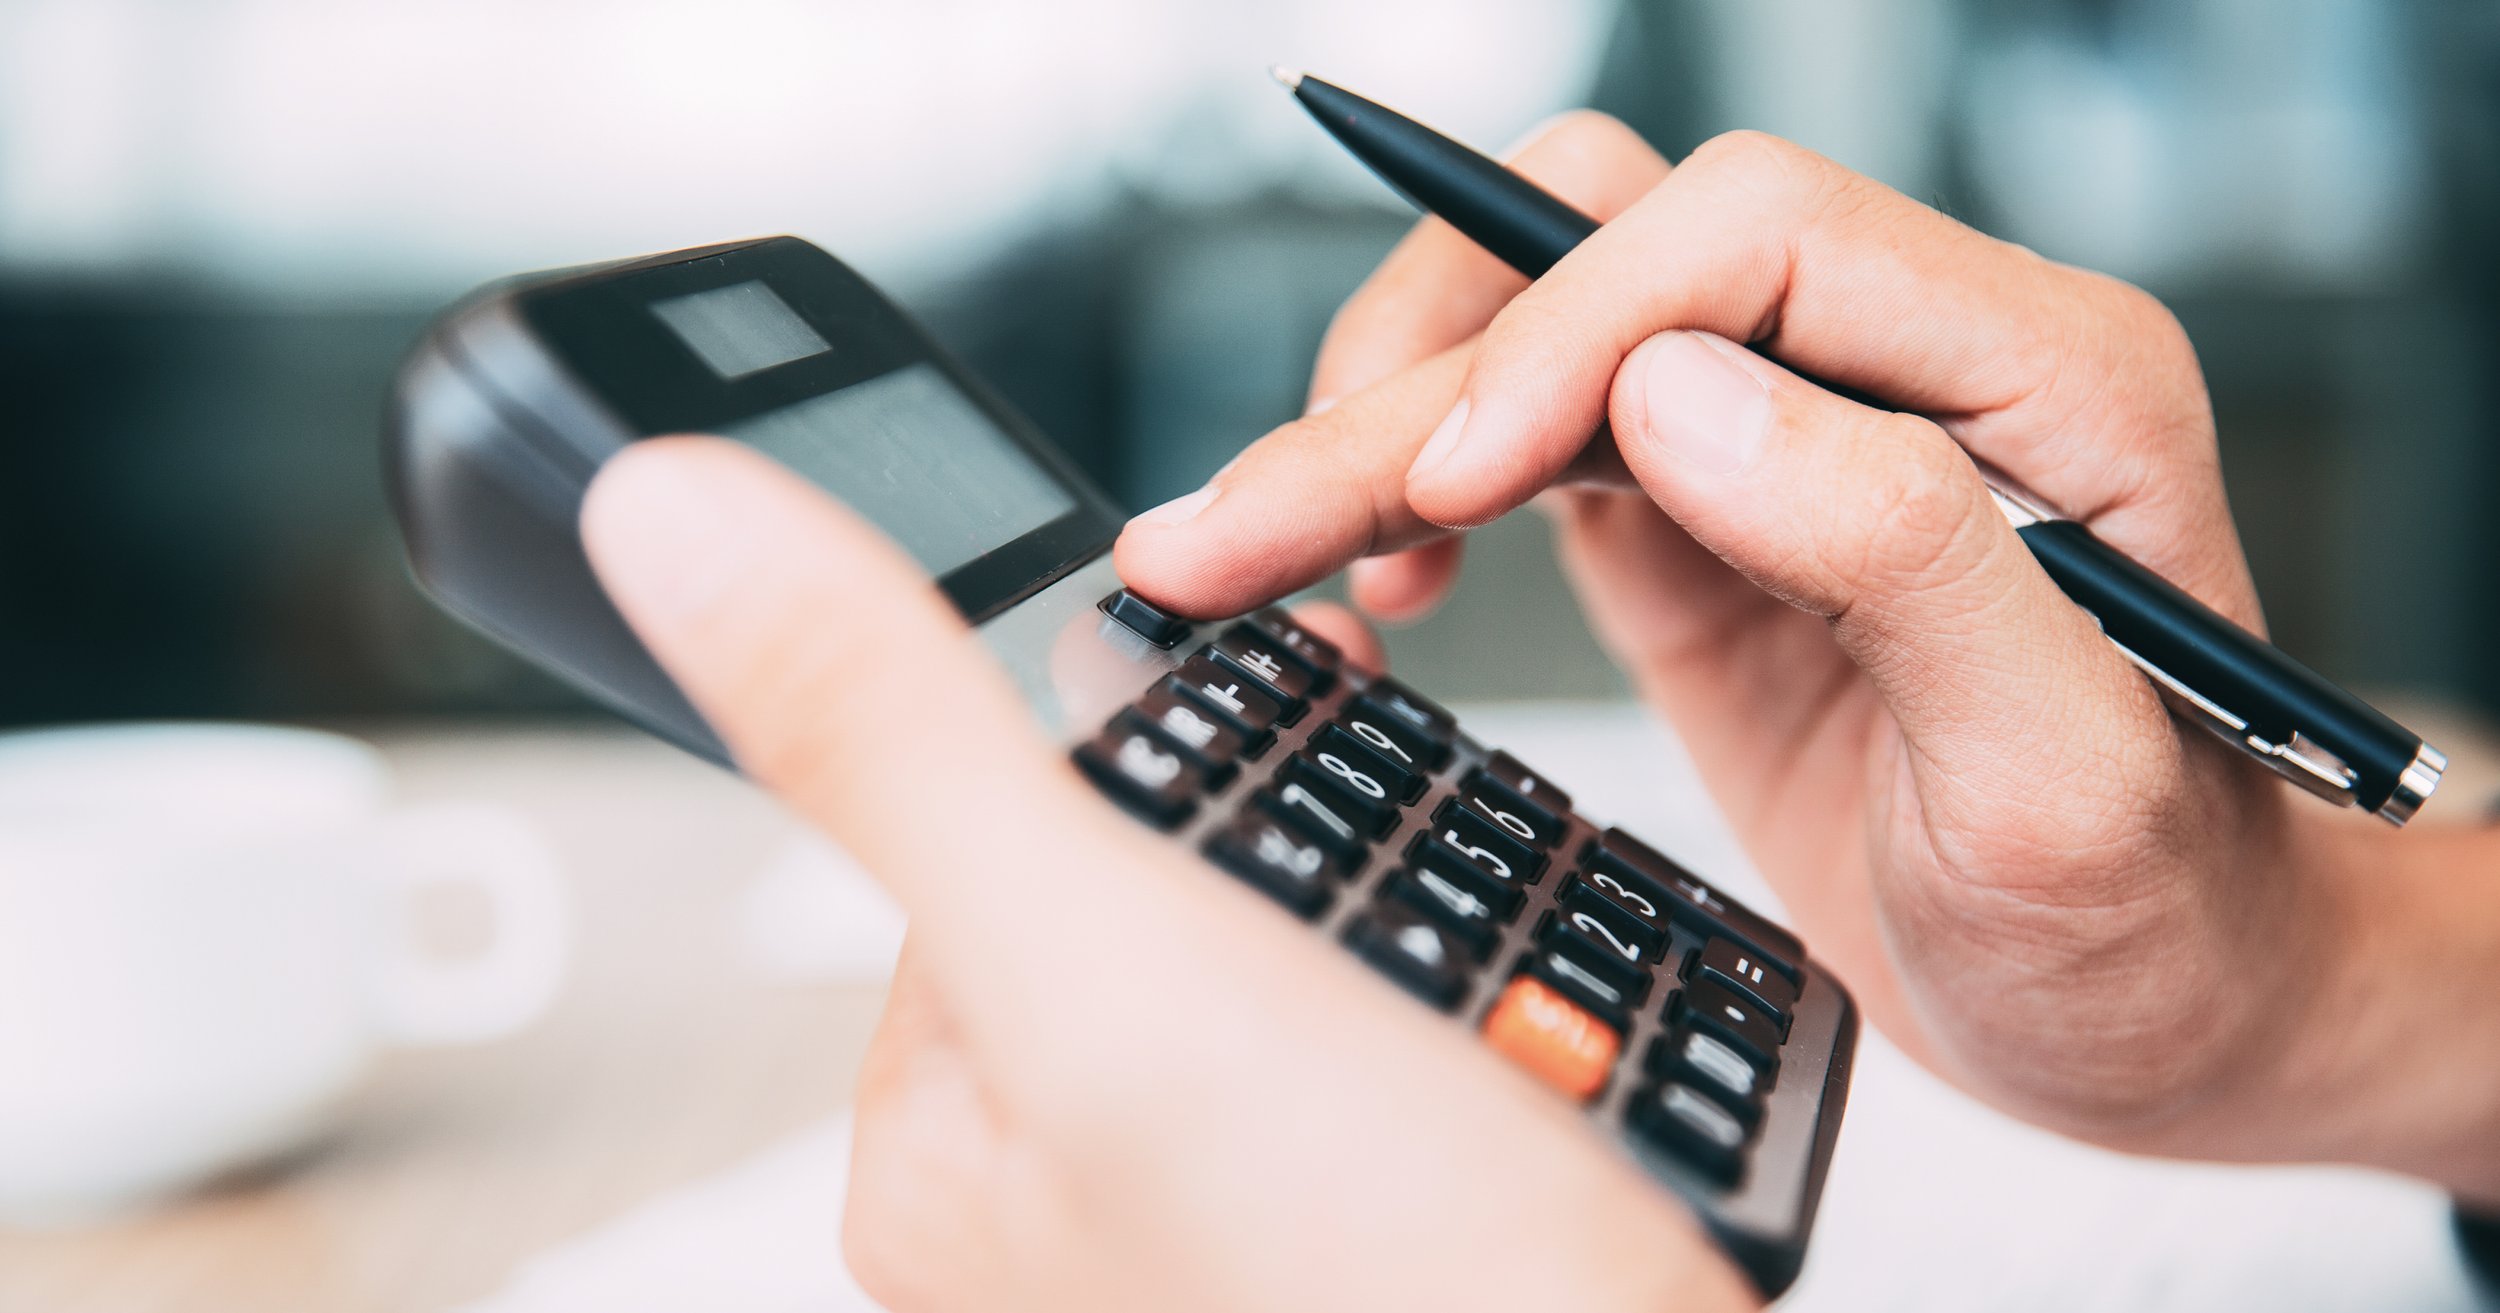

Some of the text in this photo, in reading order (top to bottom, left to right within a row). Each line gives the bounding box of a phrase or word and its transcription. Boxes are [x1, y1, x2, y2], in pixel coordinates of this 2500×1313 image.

[1351, 721, 1413, 763] 9
[1317, 752, 1386, 799] 8
[1281, 782, 1355, 840] 7
[1473, 797, 1536, 840] 6
[1444, 829, 1512, 878] 5
[1417, 867, 1490, 919] 4
[1593, 873, 1657, 917] 3
[1571, 912, 1640, 962] 2
[1550, 953, 1621, 1004] 1
